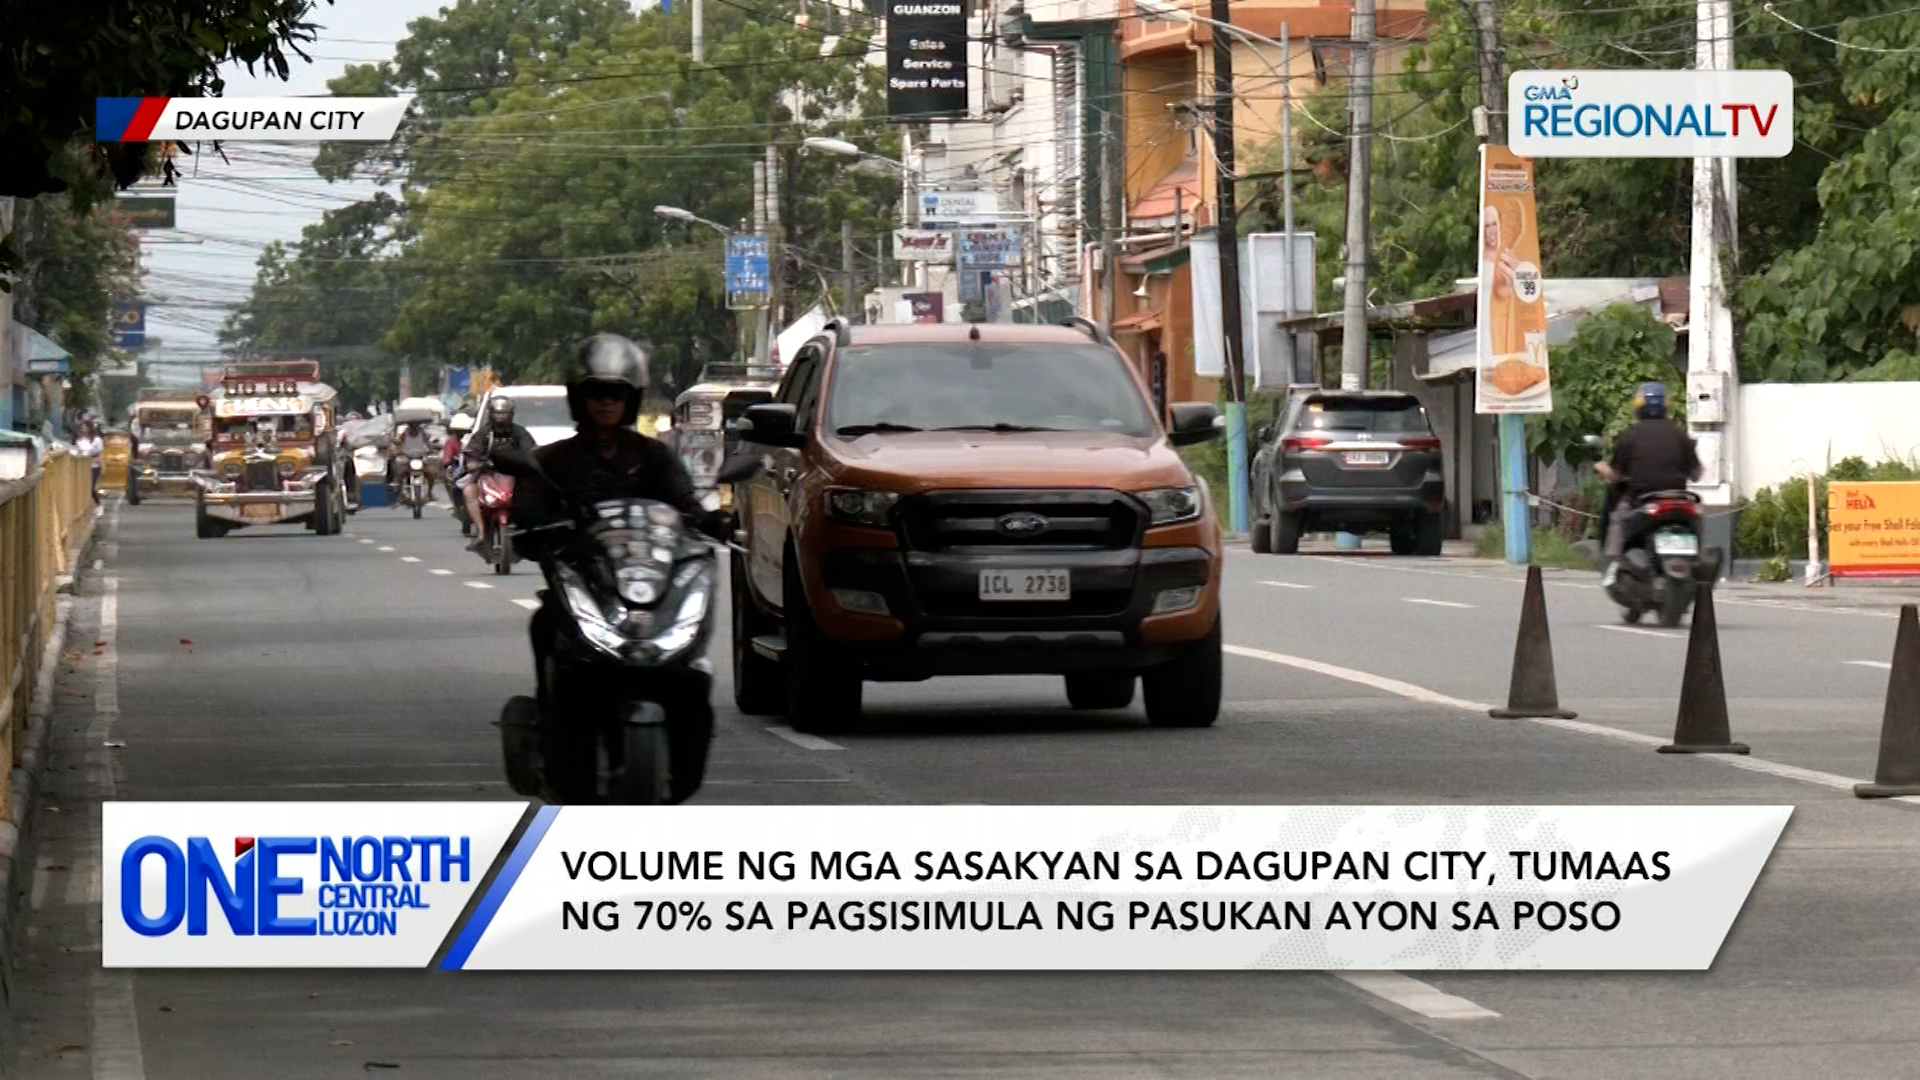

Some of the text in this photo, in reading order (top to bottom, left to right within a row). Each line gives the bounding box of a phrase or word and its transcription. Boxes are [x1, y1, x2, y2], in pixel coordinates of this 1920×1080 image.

[893, 4, 962, 16] GUANZON
[908, 38, 946, 51] Sales
[903, 58, 952, 70] Service
[889, 77, 966, 90] Spare Parts
[1863, 519, 1882, 531] Free
[1884, 517, 1904, 530] Shell
[1025, 575, 1068, 593] 2738
